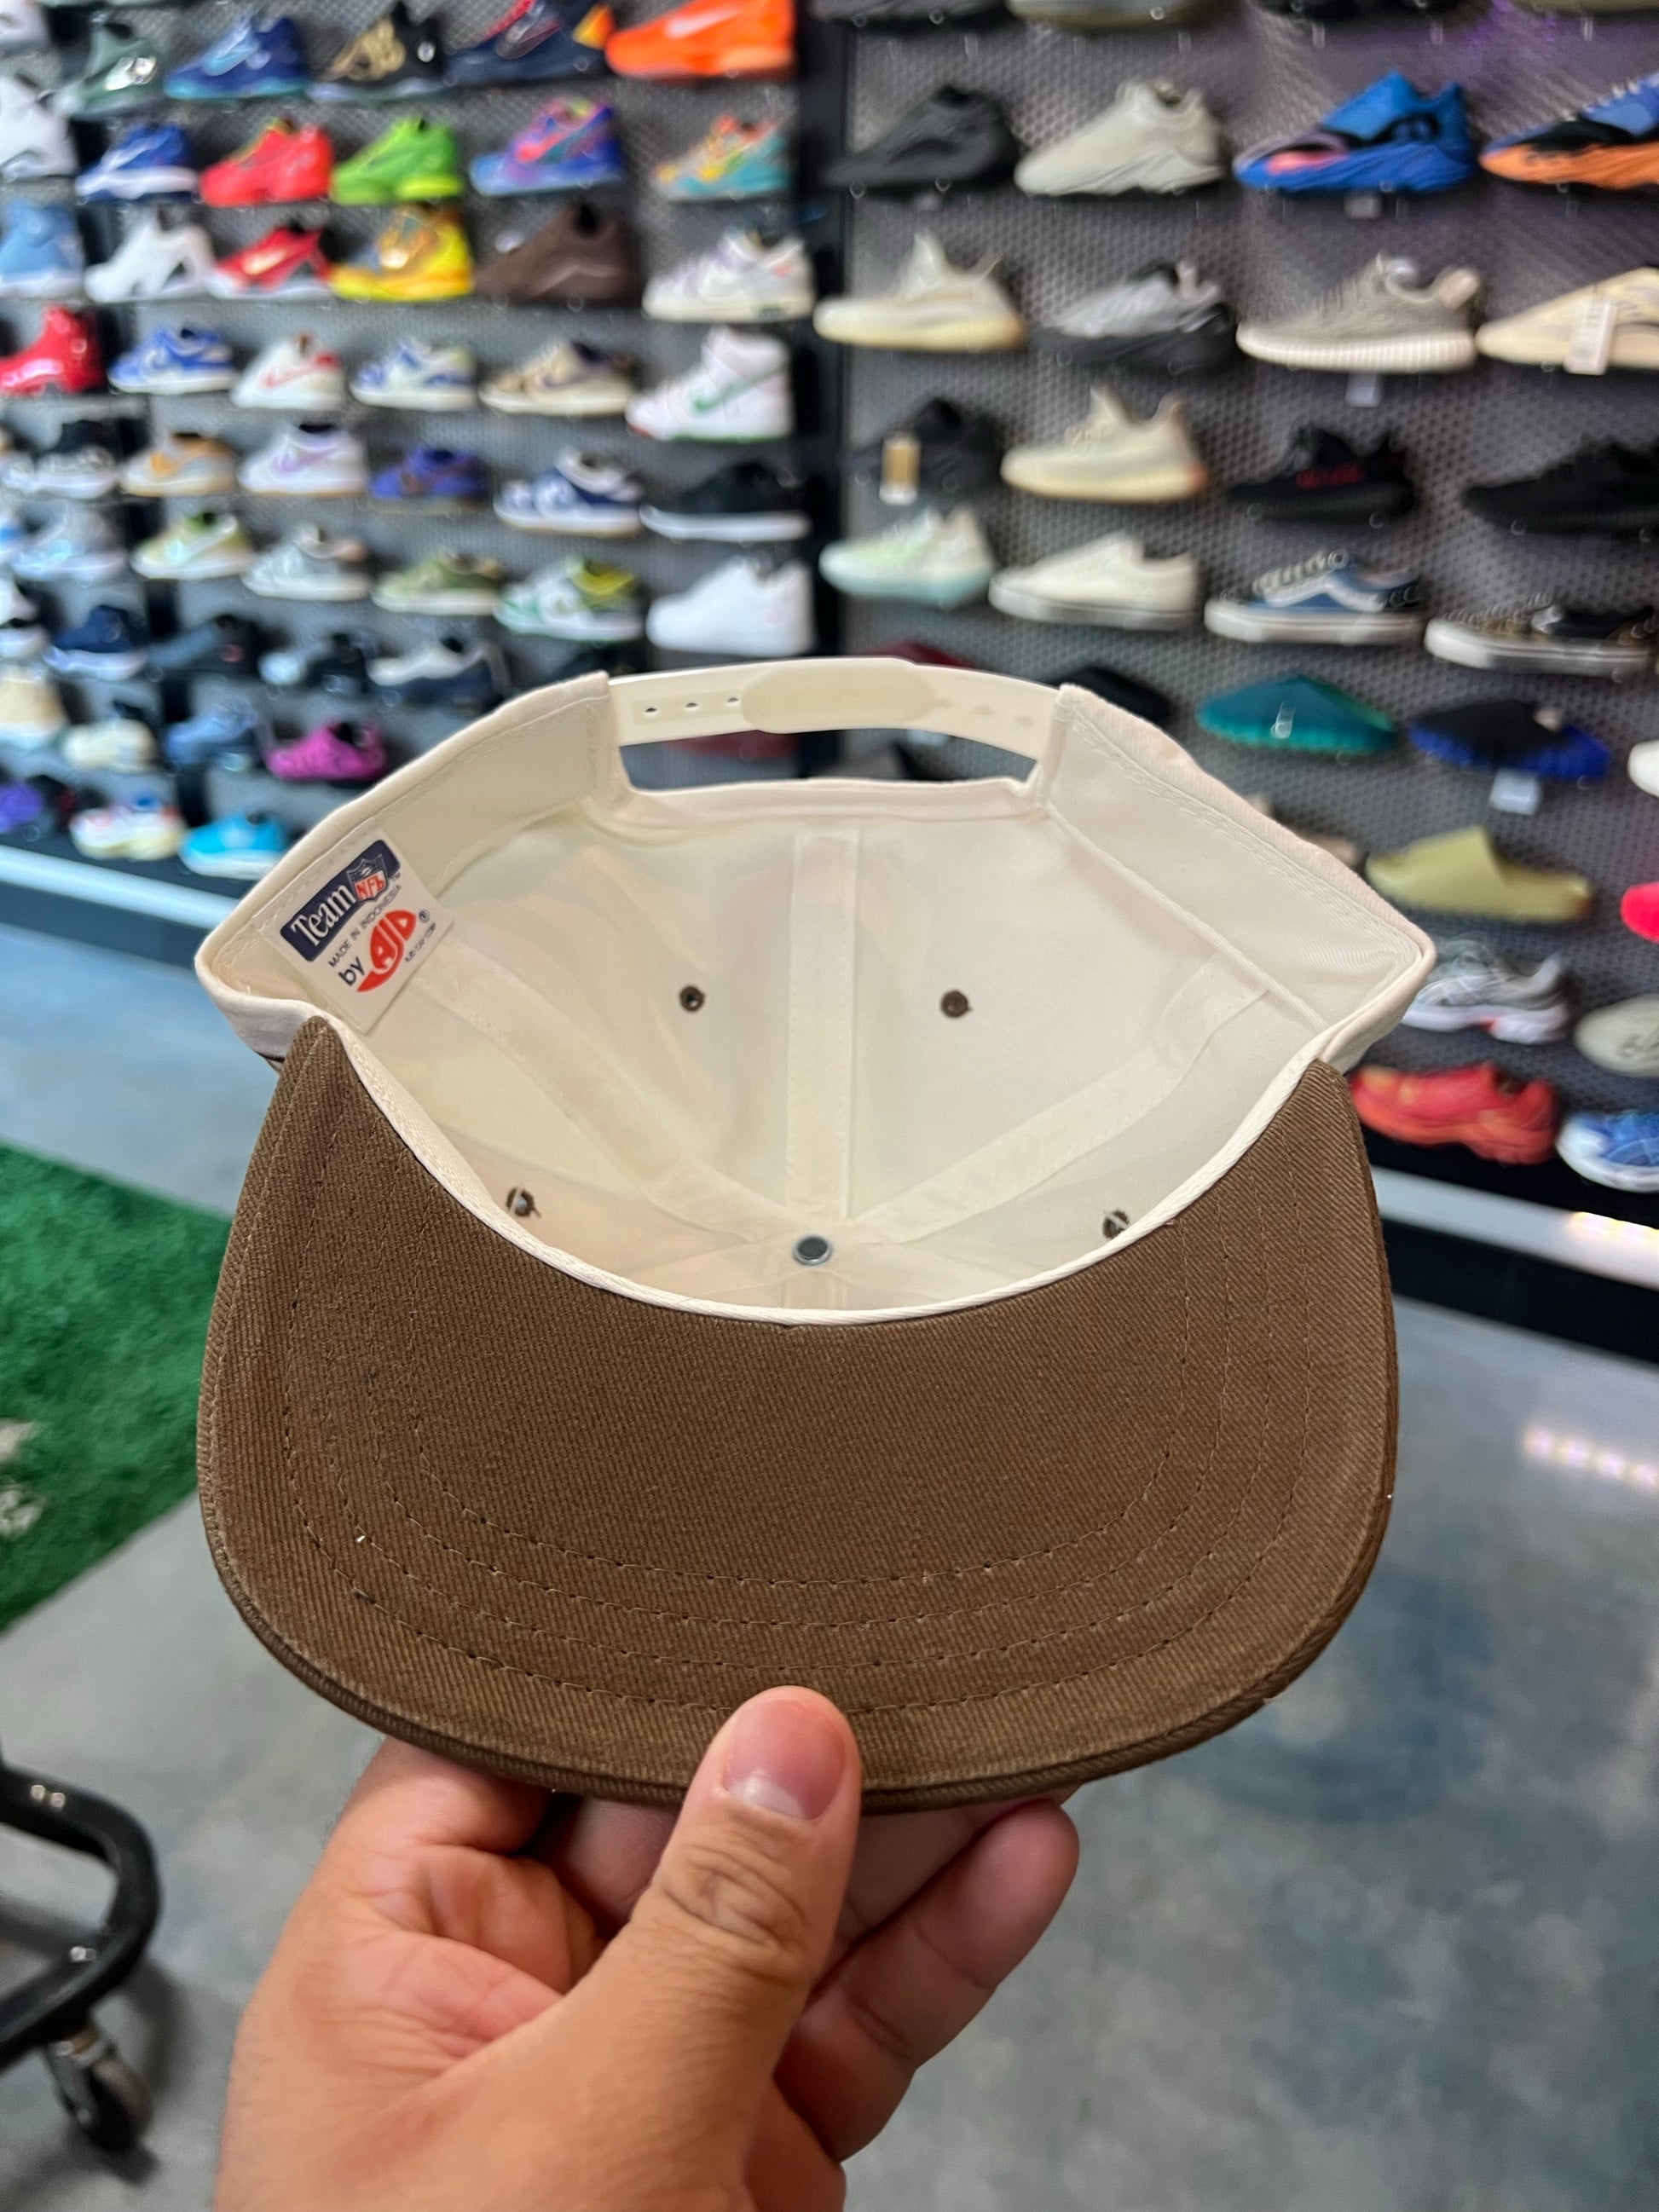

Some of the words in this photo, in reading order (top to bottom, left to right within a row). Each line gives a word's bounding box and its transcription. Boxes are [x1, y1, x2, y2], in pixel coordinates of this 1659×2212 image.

[291, 885, 356, 947] Team
[355, 875, 386, 900] NFL
[328, 939, 352, 967] MADE
[350, 927, 361, 940] IN
[338, 956, 365, 985] by
